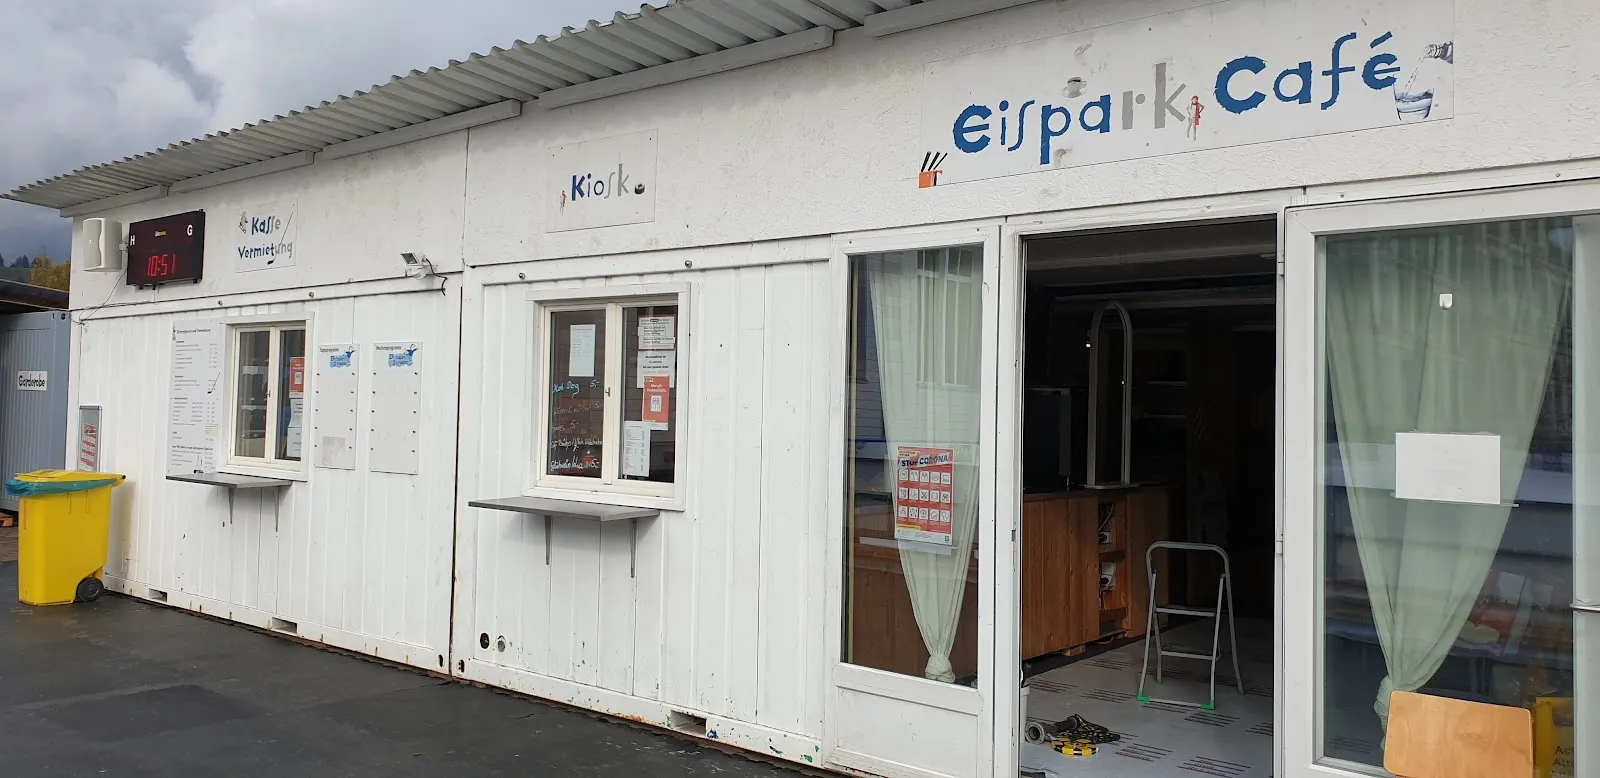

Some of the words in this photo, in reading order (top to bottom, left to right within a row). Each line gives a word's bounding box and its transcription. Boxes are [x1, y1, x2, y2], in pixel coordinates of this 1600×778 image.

[1214, 31, 1400, 114] Café
[571, 163, 629, 201] Kiosk
[187, 224, 193, 236] G
[252, 216, 281, 235] Kasse
[130, 235, 136, 246] H
[238, 242, 293, 259] Vermietung
[148, 254, 176, 276] 10:51
[19, 374, 45, 387] Garderobe
[901, 459, 918, 467] STOP
[919, 455, 949, 465] CORONA
